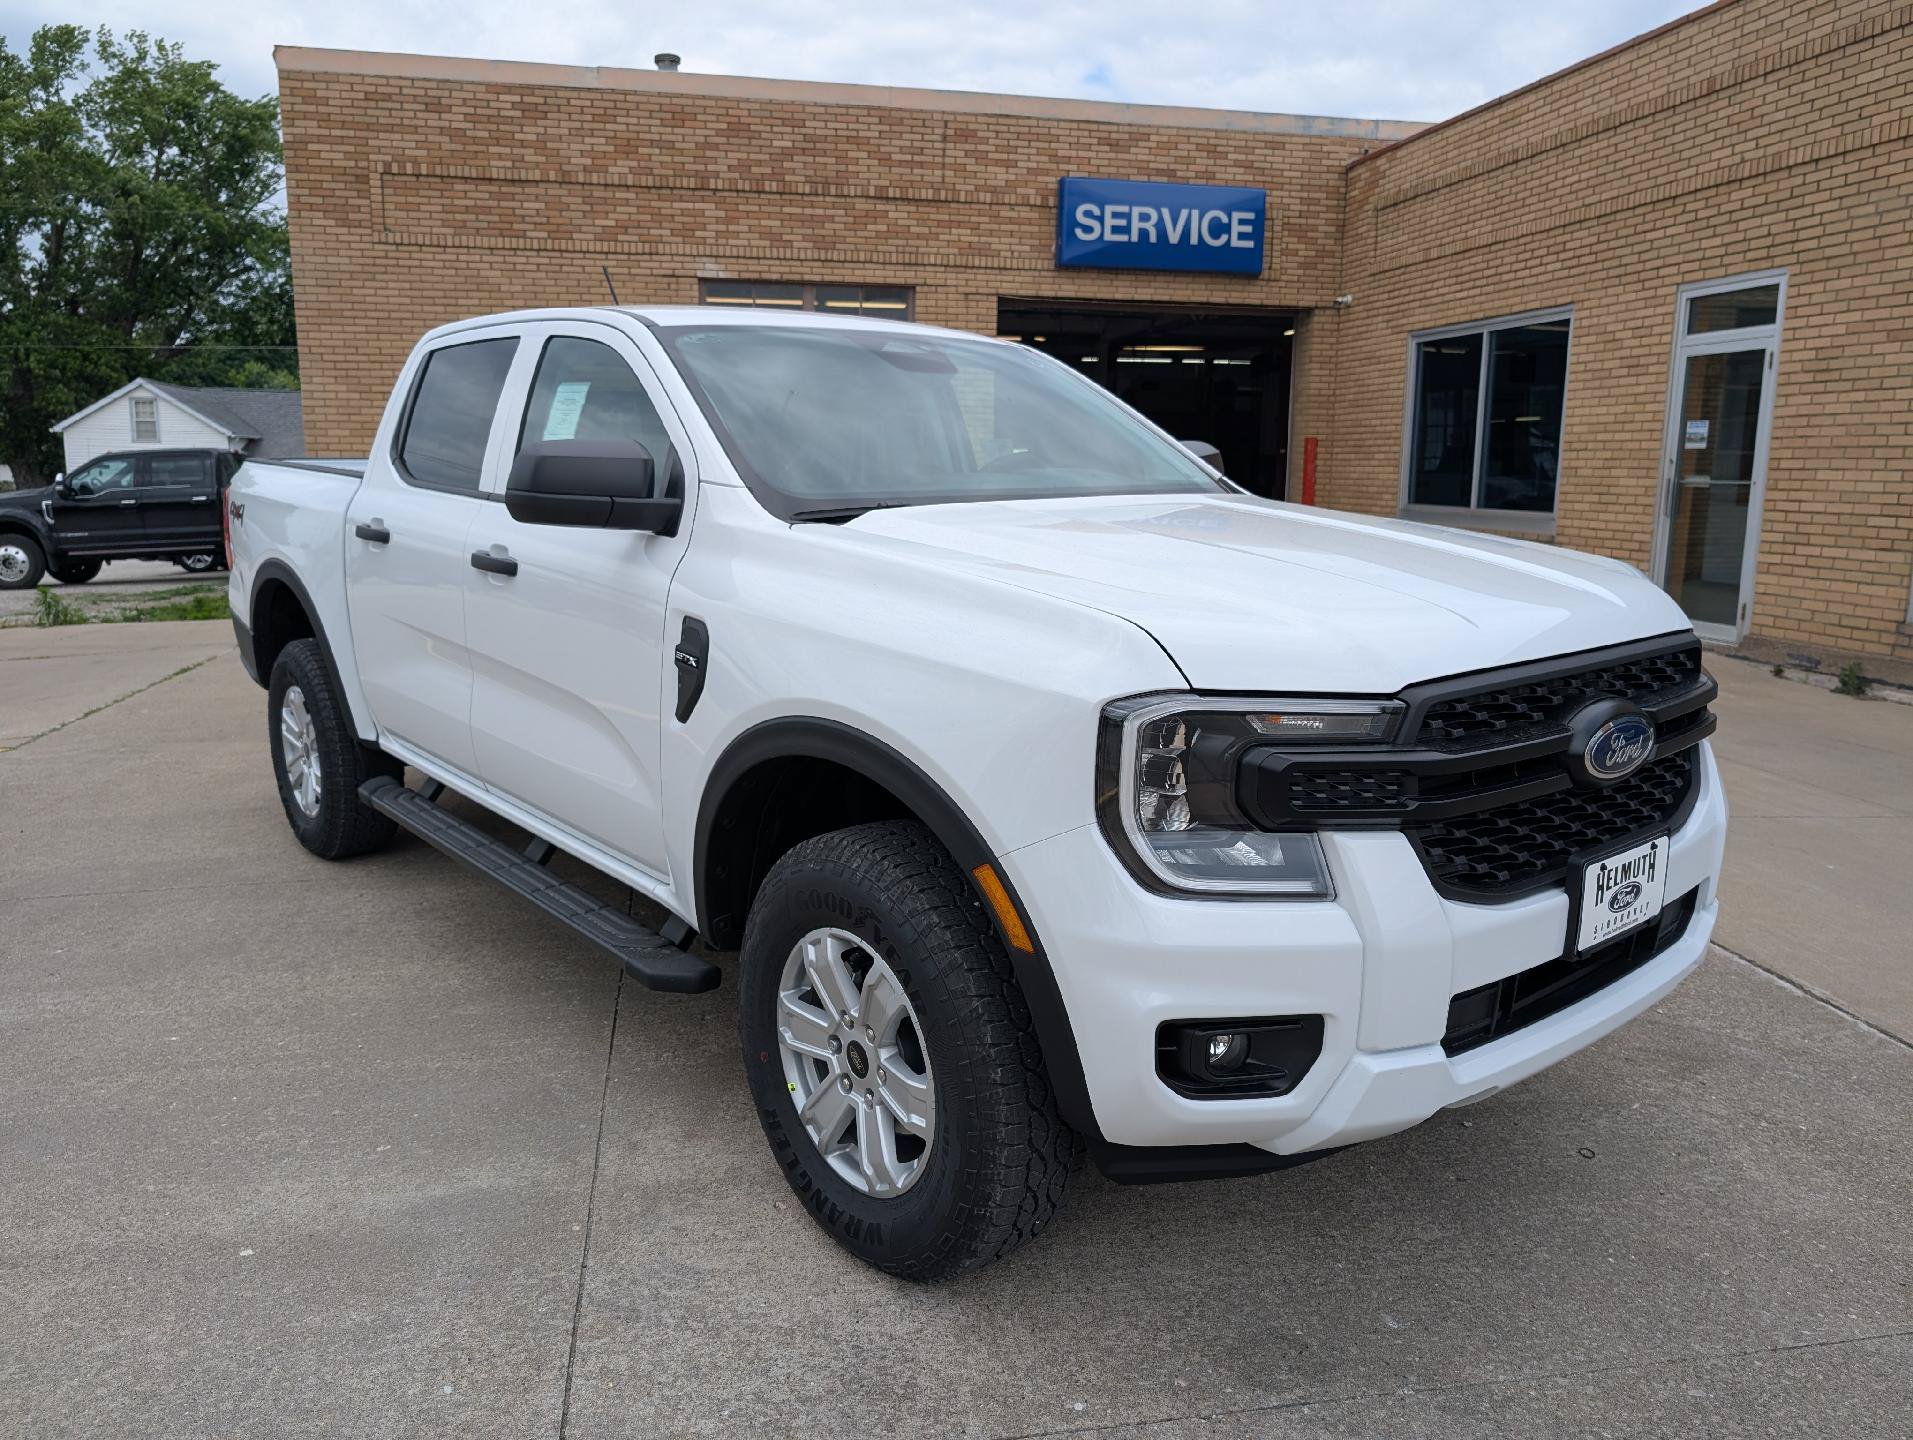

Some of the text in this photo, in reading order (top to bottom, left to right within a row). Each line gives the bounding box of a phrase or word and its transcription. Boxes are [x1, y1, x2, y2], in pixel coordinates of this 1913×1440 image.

[1074, 203, 1256, 249] SERVICE
[675, 651, 699, 668] STX
[1605, 732, 1643, 768] Ford
[1595, 849, 1657, 908] HELMUTH
[1613, 884, 1639, 910] Ford
